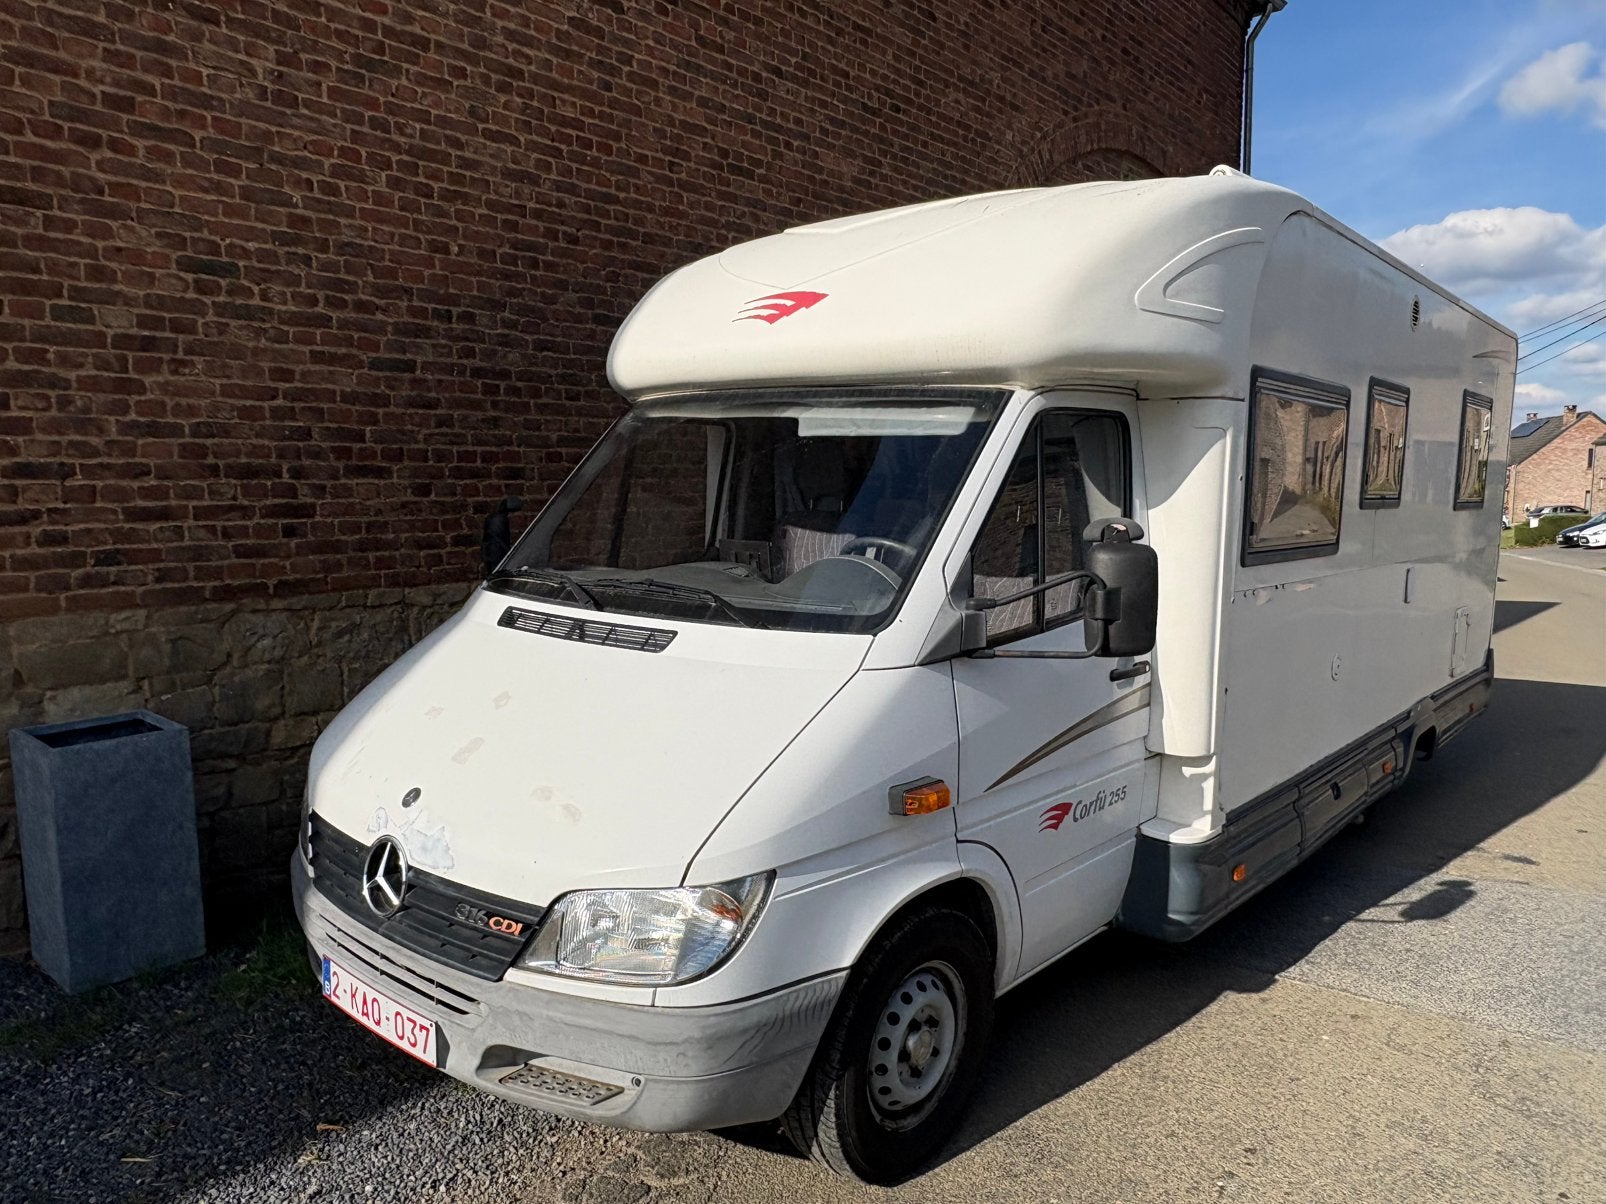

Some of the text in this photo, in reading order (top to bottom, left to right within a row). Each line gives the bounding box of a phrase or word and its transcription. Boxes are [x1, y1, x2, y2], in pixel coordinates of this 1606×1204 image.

[1107, 785, 1128, 807] 255
[488, 916, 523, 936] CDI
[324, 980, 331, 995] B
